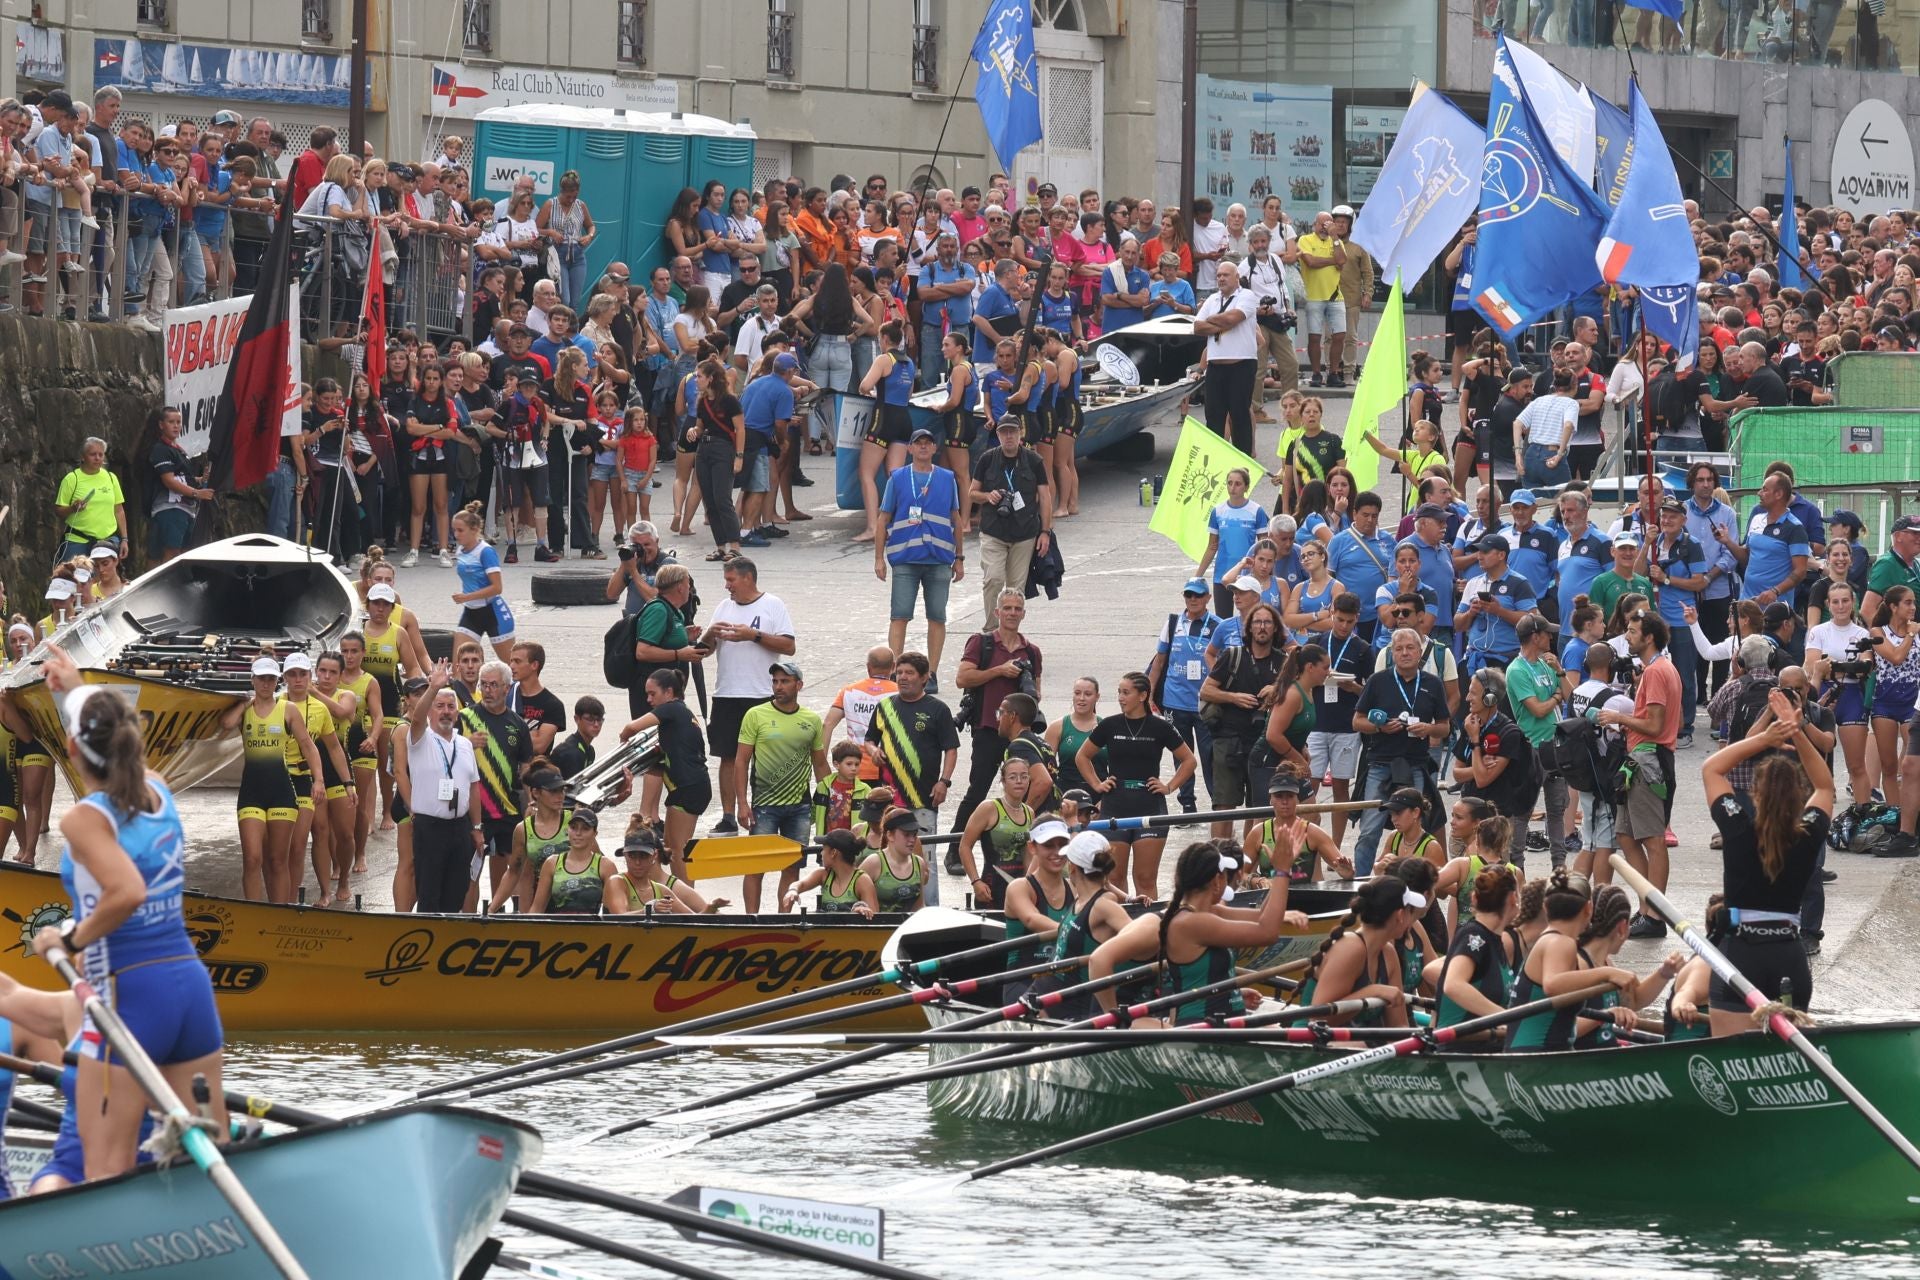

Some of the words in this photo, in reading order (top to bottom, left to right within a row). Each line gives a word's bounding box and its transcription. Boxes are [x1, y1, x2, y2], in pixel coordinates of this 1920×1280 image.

[492, 72, 519, 92] Real
[523, 74, 553, 94] Club
[556, 76, 605, 97] Náutico
[853, 412, 868, 437] 11
[275, 937, 327, 952] LEMOS
[437, 938, 634, 980] CEFYCAL
[637, 936, 884, 993] Amegrov
[1722, 1045, 1833, 1082] AISLAMIENTS
[1363, 1073, 1442, 1091] CARROCERIAS
[1533, 1071, 1673, 1112] AUTONERVION
[1747, 1079, 1829, 1105] GALDAKAO
[759, 1203, 796, 1219] Parque
[797, 1209, 811, 1219] de
[812, 1210, 822, 1221] la
[822, 1212, 876, 1228] Naturaleza
[80, 1217, 248, 1275] VILAXOAN
